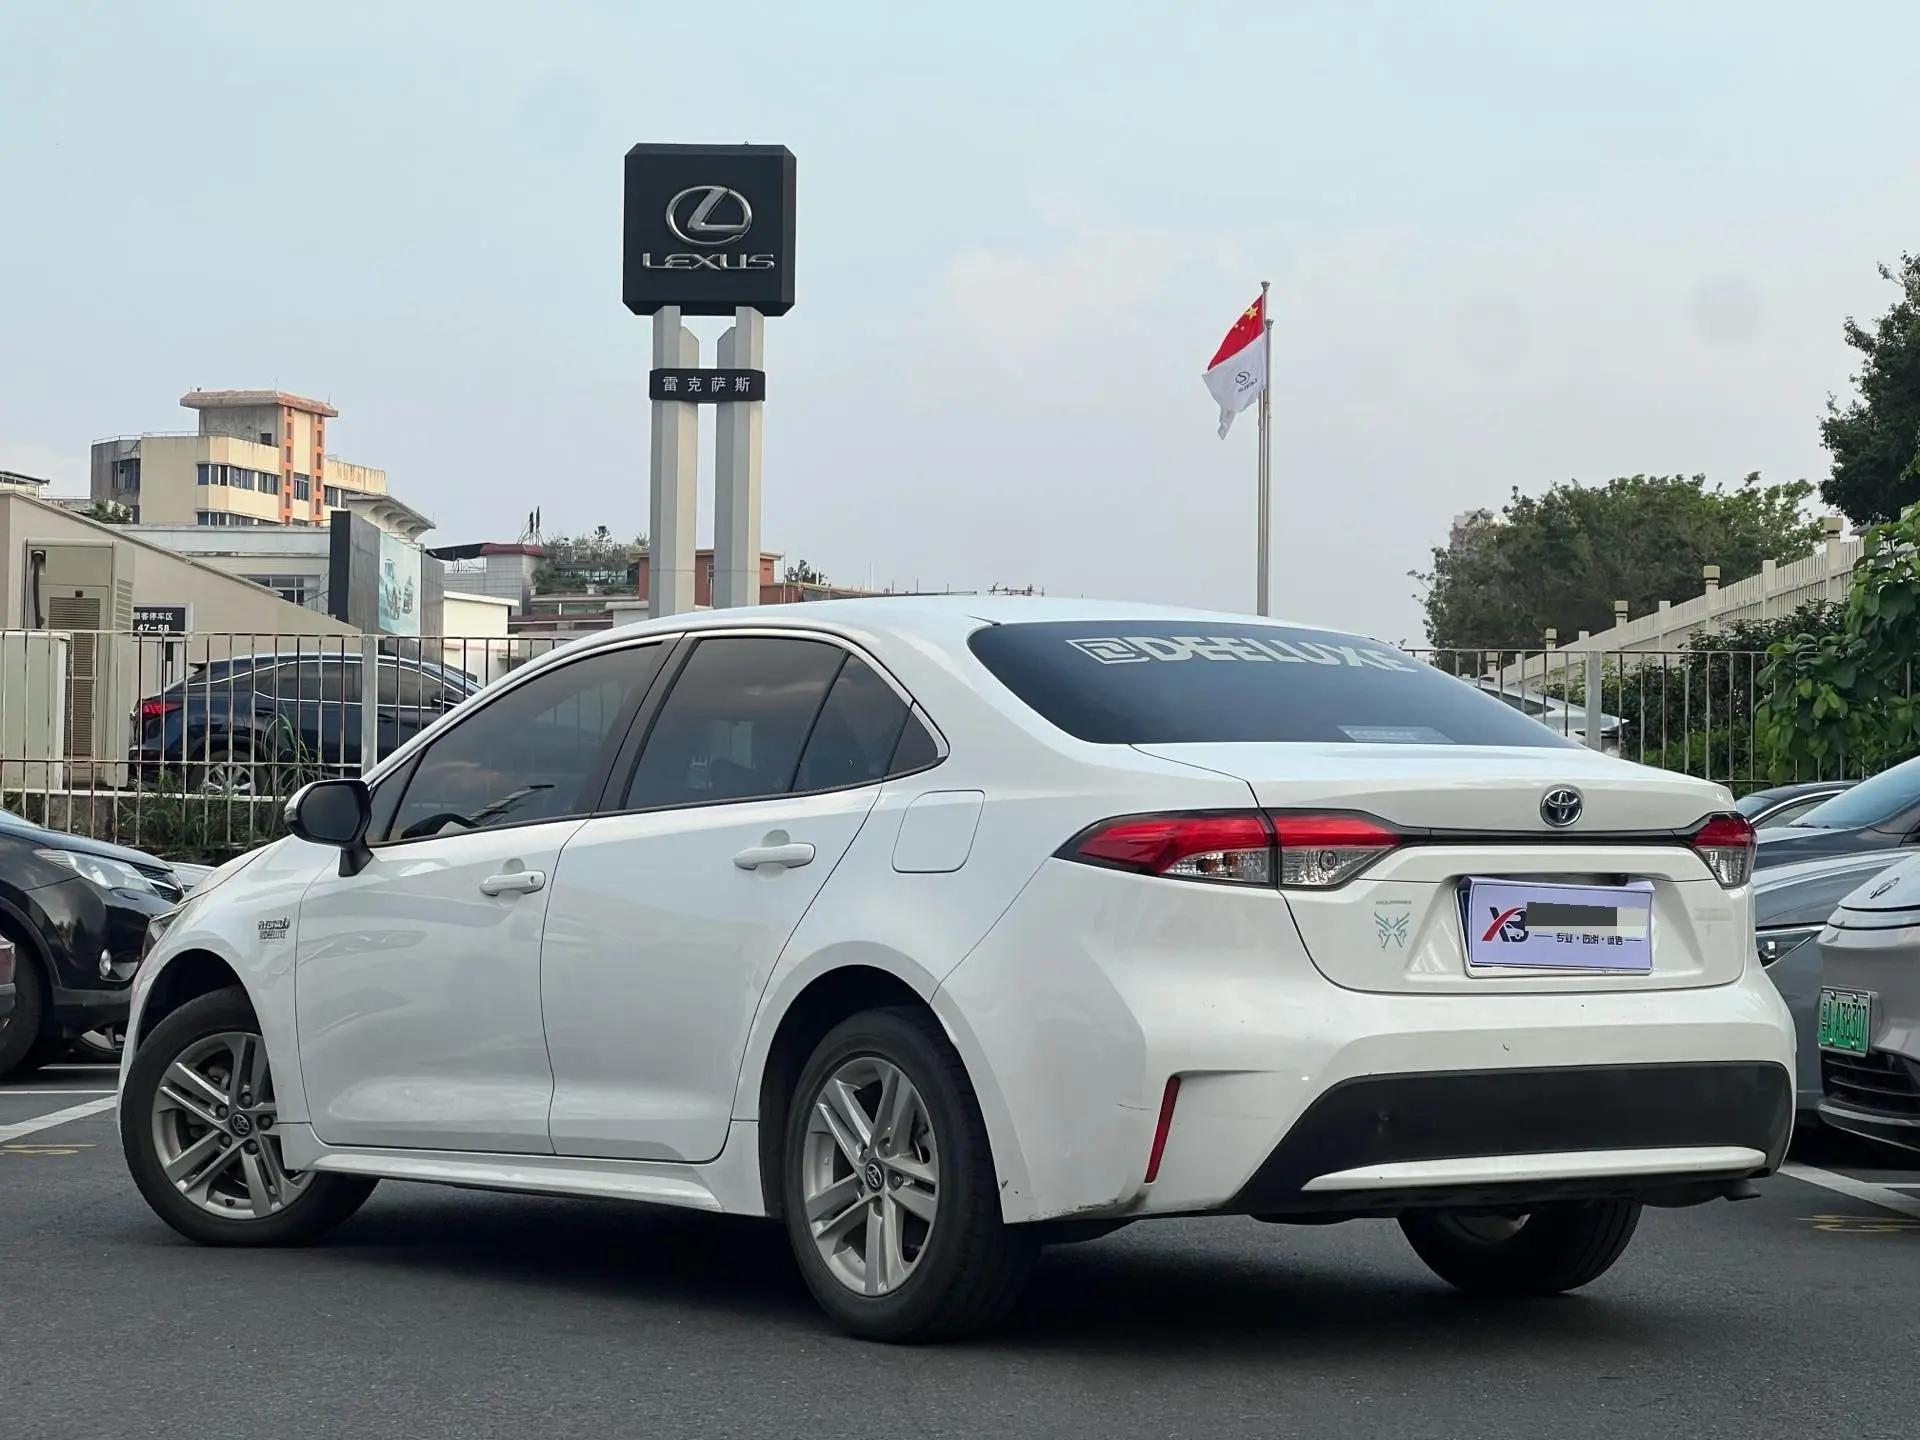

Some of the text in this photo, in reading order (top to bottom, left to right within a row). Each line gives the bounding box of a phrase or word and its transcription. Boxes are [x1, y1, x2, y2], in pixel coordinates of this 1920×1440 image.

[642, 252, 775, 271] LEXUS
[663, 376, 751, 392] 雷克萨斯
